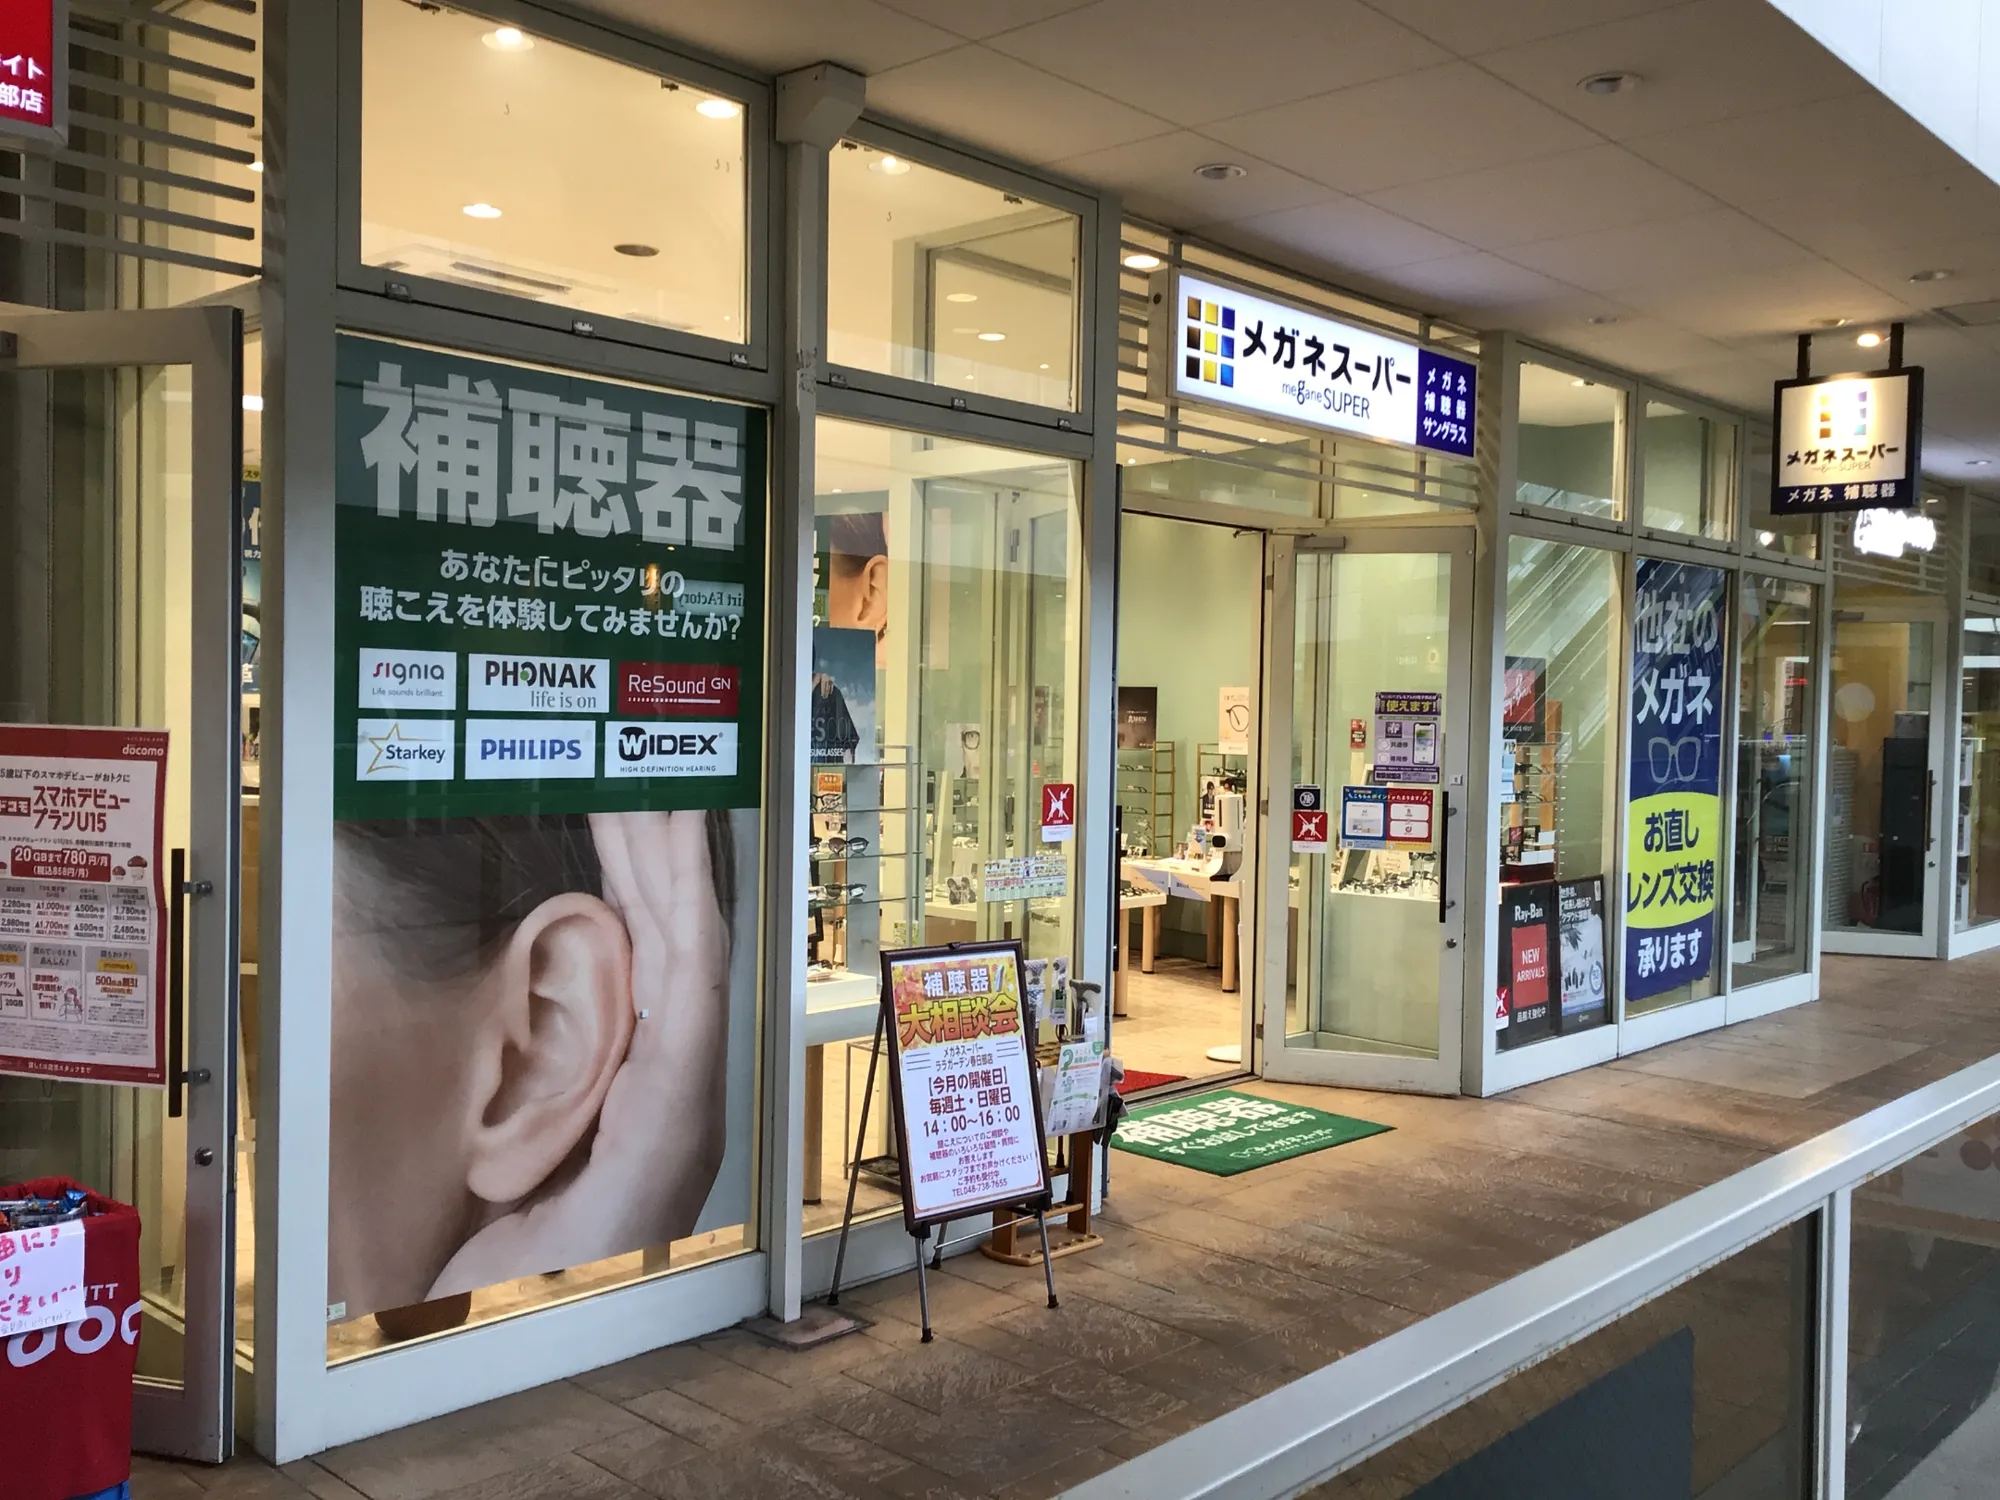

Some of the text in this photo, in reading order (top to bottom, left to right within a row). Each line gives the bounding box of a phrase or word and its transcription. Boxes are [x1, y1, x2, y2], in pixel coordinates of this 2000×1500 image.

[0, 53, 45, 80] イト
[1242, 319, 1411, 395] メガネスーパー
[1426, 367, 1467, 395] メガネ
[1424, 390, 1467, 420] 補聴器
[1423, 417, 1467, 445] サングラス
[360, 361, 742, 551] 補聴器
[1787, 482, 1896, 503] メガネ 補聴器
[440, 549, 685, 598] あなたにピッタリの
[360, 585, 741, 641] 聴こえを体験してみませんか?
[1635, 589, 1719, 655] 他社の
[372, 662, 445, 685] signia
[485, 660, 597, 689] PHONAK
[628, 674, 731, 696] ReSound GN
[388, 688, 414, 697] sounds
[530, 690, 597, 709] life is on
[1636, 667, 1713, 725] メガネ
[122, 744, 164, 757] docomo
[385, 744, 446, 765] Starkey
[480, 739, 582, 761] PHILIPS
[618, 726, 718, 761] WIDEX
[619, 764, 717, 773] HIGH DEFINITION HEARING
[33, 785, 130, 810] スマホデビュー
[33, 808, 107, 832] プランU15
[1644, 808, 1700, 853] お直し
[1627, 860, 1715, 914] レンズ交換
[1514, 903, 1543, 923] Ray-Ban
[1522, 948, 1540, 965] NEW
[1637, 928, 1702, 979] 承ります
[923, 966, 989, 998] 補聴器
[1517, 966, 1545, 982] ARRIVALS
[900, 992, 1020, 1047] 大相談会
[935, 1053, 994, 1072] ララガーデン春日部店
[944, 1043, 984, 1058] メガネスーパー
[929, 1086, 1011, 1116] 毎週土・日曜日
[1112, 1097, 1289, 1146] 補聴器
